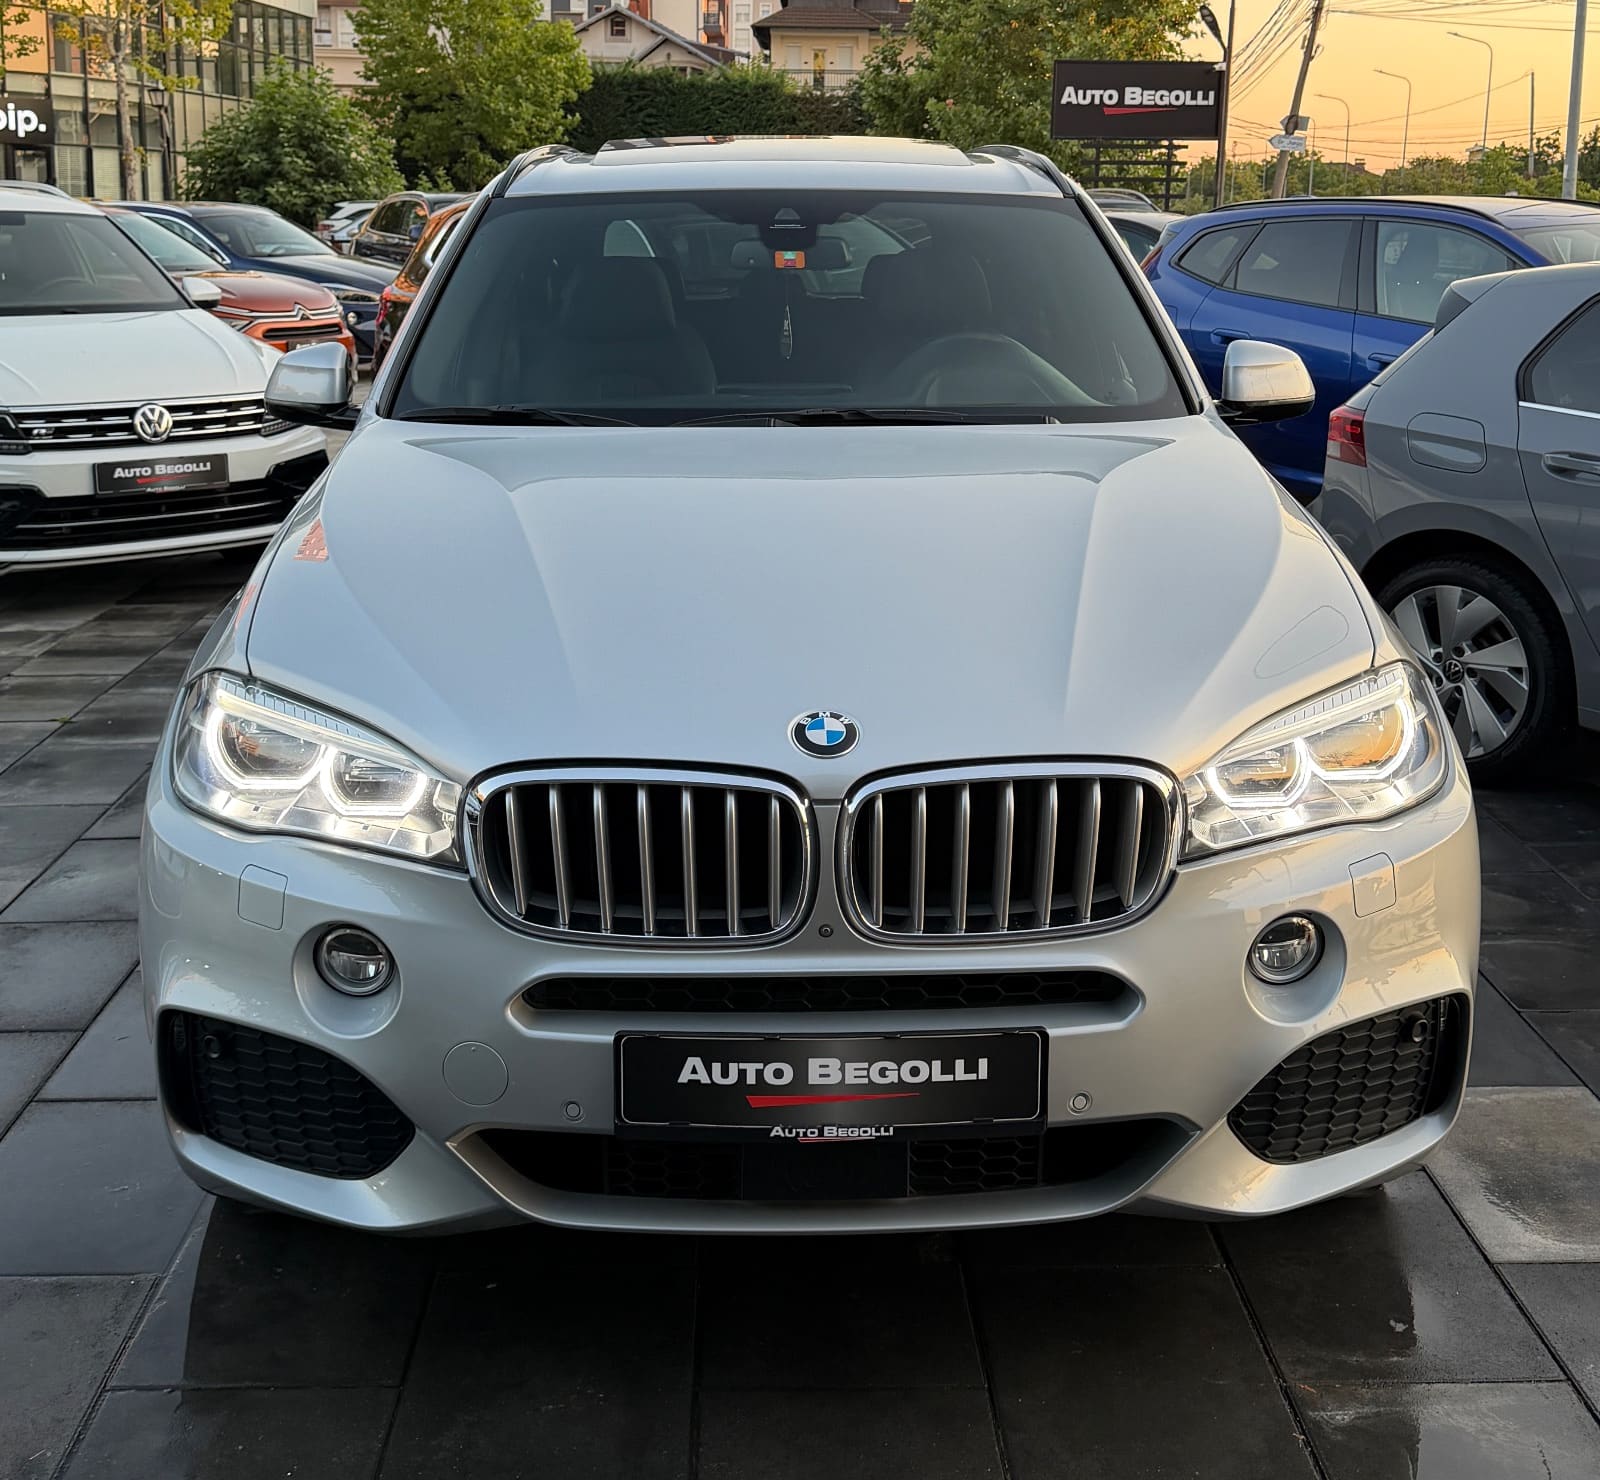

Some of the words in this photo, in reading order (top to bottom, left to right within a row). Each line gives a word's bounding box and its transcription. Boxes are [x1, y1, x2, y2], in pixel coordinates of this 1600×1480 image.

[1060, 86, 1119, 105] AUTO
[1124, 87, 1215, 106] BEGOLLI
[113, 467, 152, 479] AUTO
[154, 461, 211, 475] BEGOLLI
[799, 711, 852, 725] BMW
[677, 1056, 794, 1085] AUTO
[807, 1057, 988, 1085] BEGOLLI
[769, 1126, 819, 1138] AUTO
[823, 1126, 894, 1137] BEGOLLI
